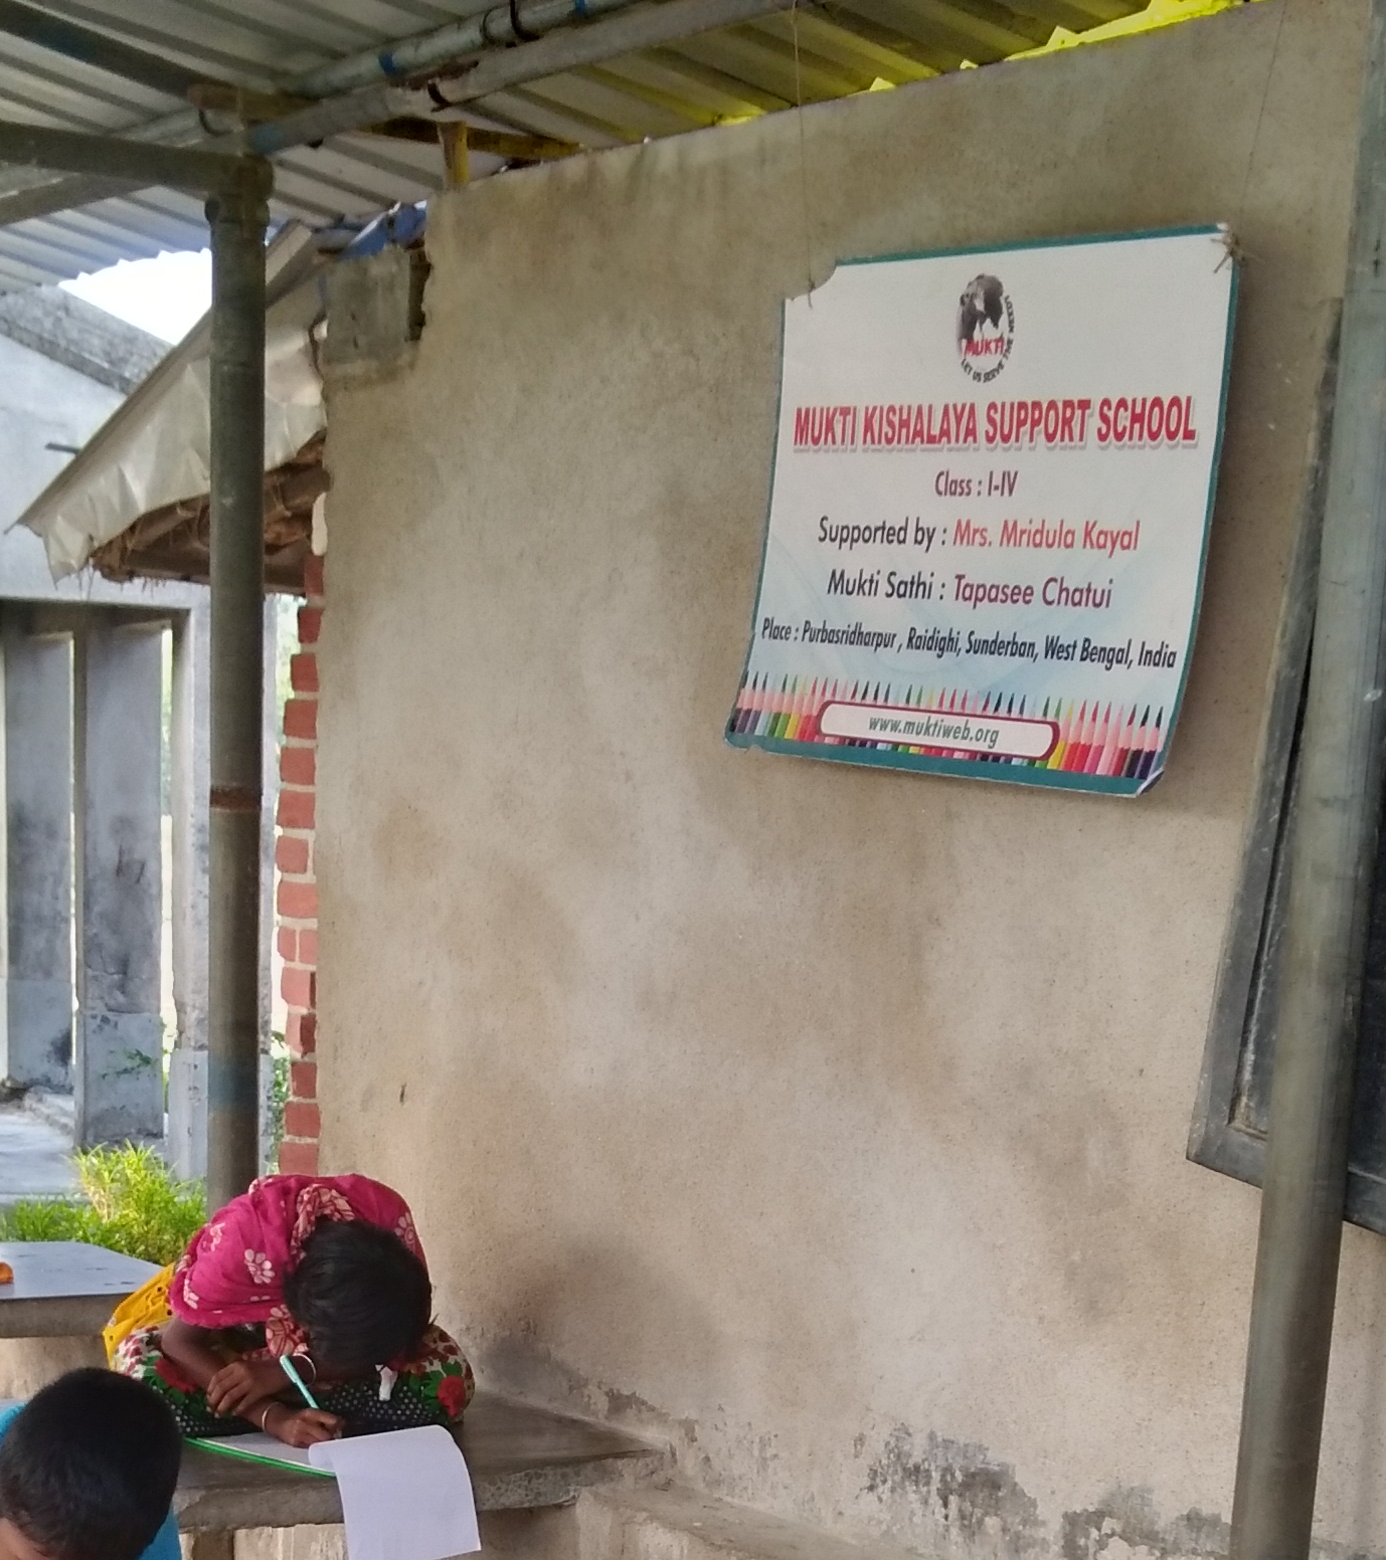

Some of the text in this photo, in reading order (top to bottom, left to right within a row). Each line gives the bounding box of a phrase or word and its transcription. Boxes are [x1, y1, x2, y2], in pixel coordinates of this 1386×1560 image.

[794, 395, 1197, 447] MUKTI KISHALAYA SUPPORT SCHOOL
[934, 469, 972, 497] Class
[987, 469, 1019, 497] I-IV
[817, 514, 910, 551] Supported
[913, 516, 937, 554] by
[953, 518, 992, 548] Mrs.
[999, 517, 1076, 549] Mridula
[1082, 518, 1141, 560] Kayal
[827, 568, 881, 597] Mukti
[885, 570, 935, 600] Sathi
[954, 573, 1034, 610] Tapasee
[1042, 576, 1114, 609] Chatui
[762, 616, 792, 641] Place
[801, 619, 898, 654] Purbasridharpur
[965, 629, 1040, 663] Sunderban,
[1043, 634, 1078, 662] West
[1079, 636, 1135, 672] Bengal,
[1137, 640, 1178, 669] India
[868, 714, 1000, 749] www.muktiweb.org
